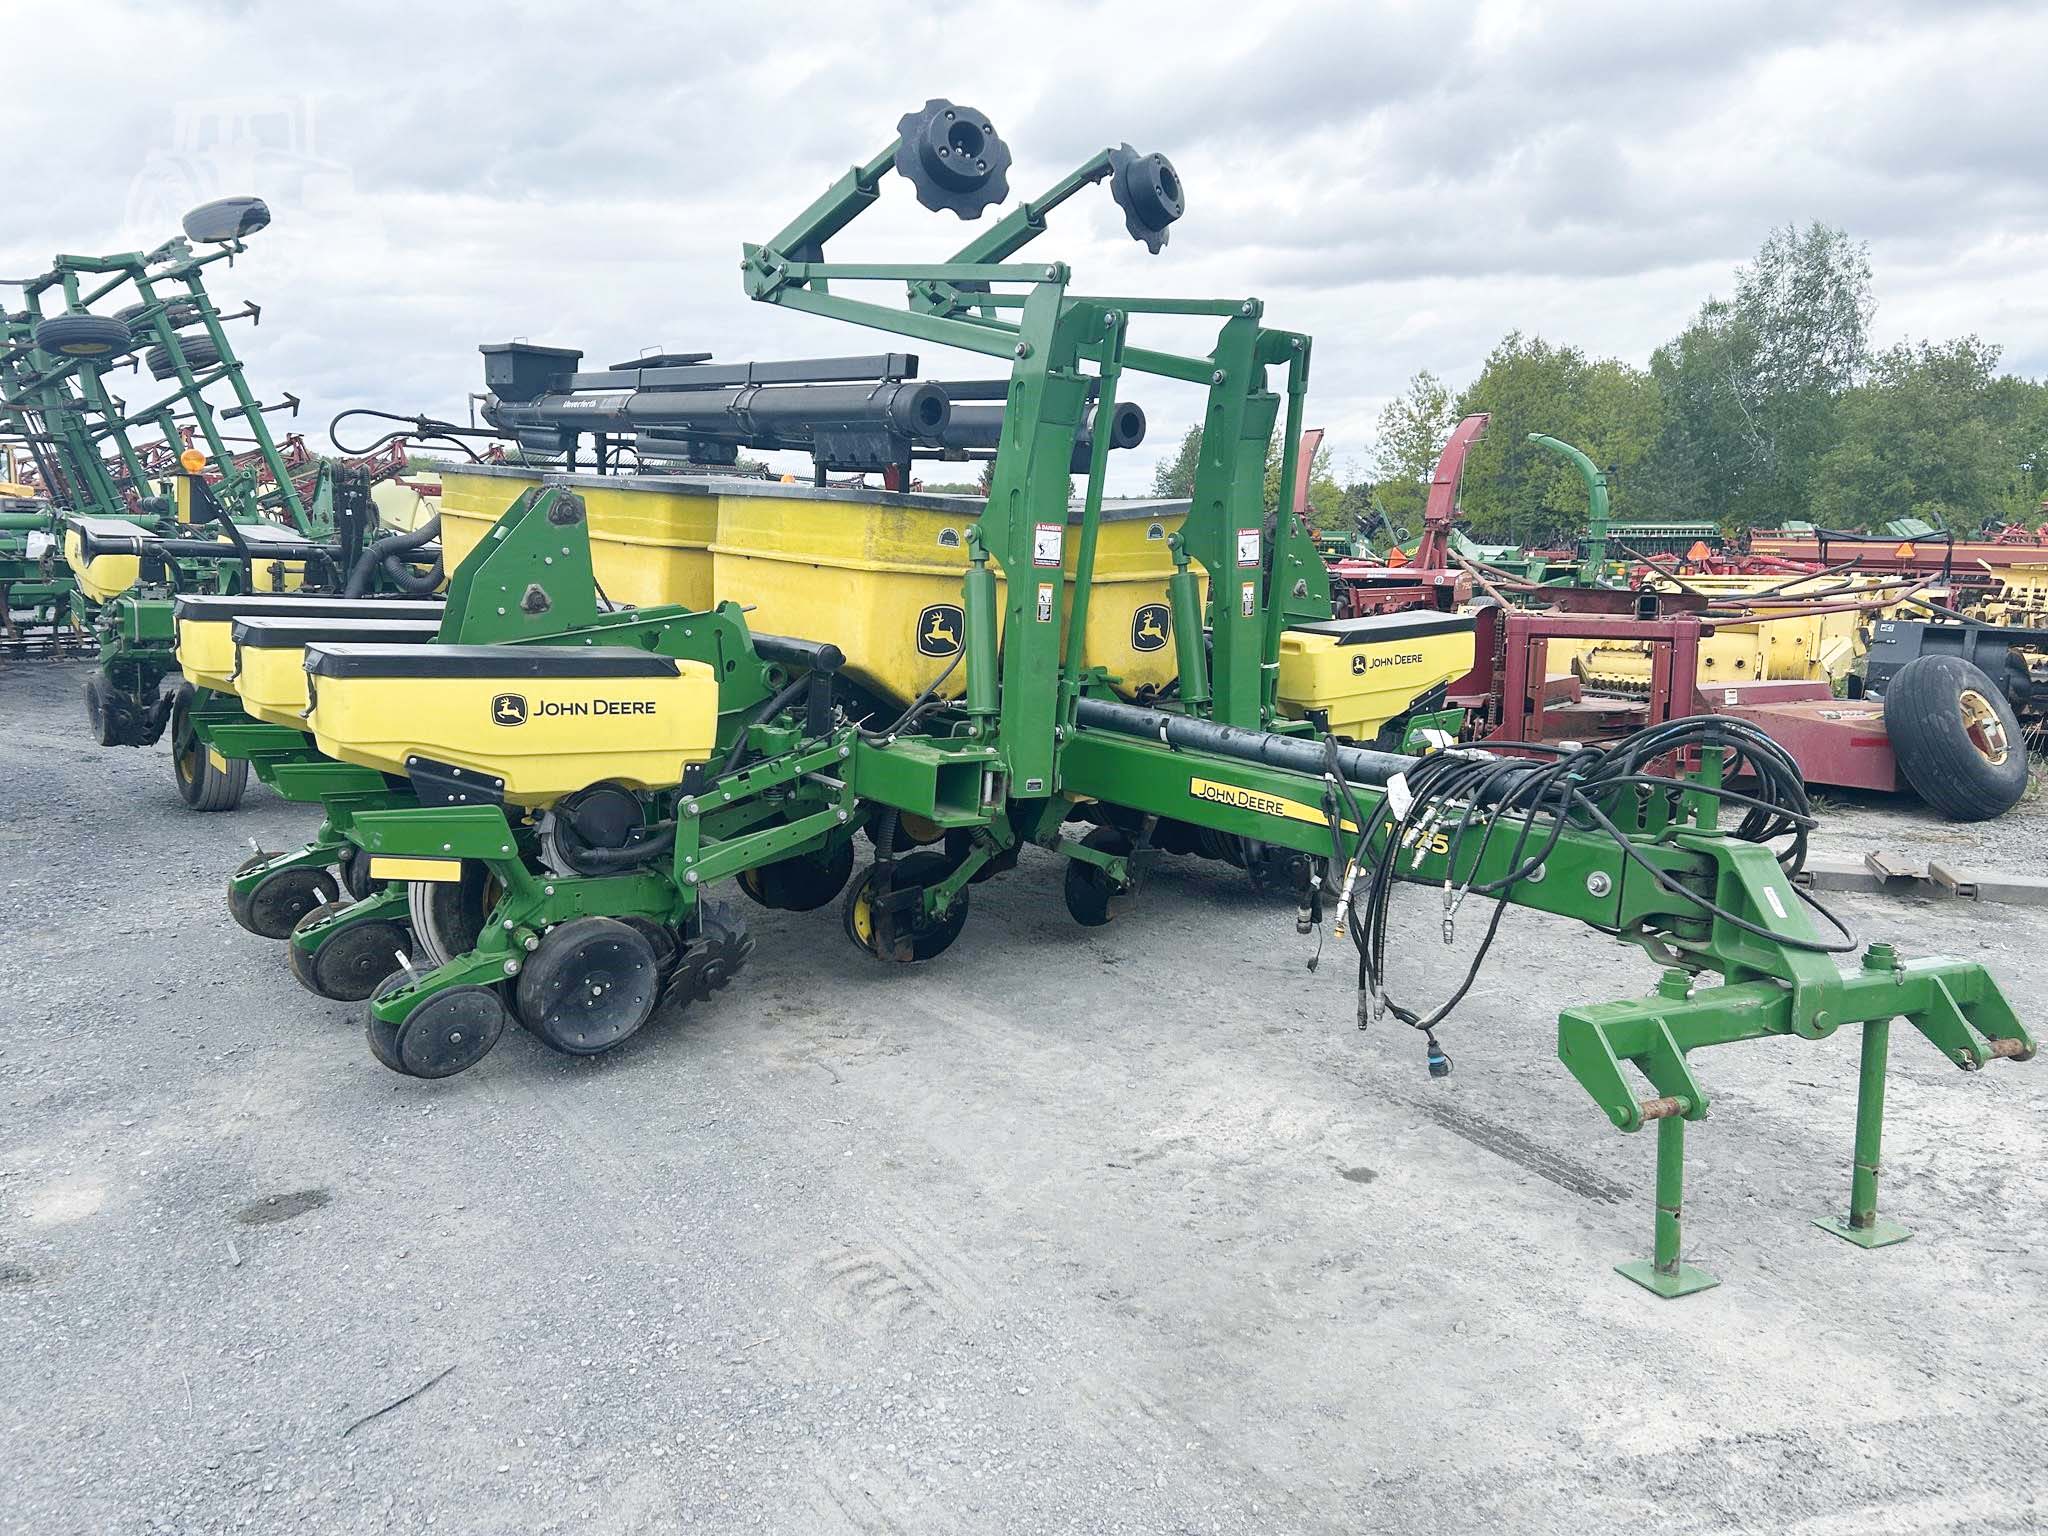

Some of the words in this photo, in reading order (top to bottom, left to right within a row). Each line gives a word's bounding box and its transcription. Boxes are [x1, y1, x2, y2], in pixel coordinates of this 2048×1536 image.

[1369, 658, 1393, 669] JOHN
[1394, 654, 1423, 665] DEERE
[533, 700, 588, 716] JOHN
[593, 700, 656, 715] DEERE
[1199, 783, 1235, 803] JOHN
[1238, 791, 1284, 815] DEERE
